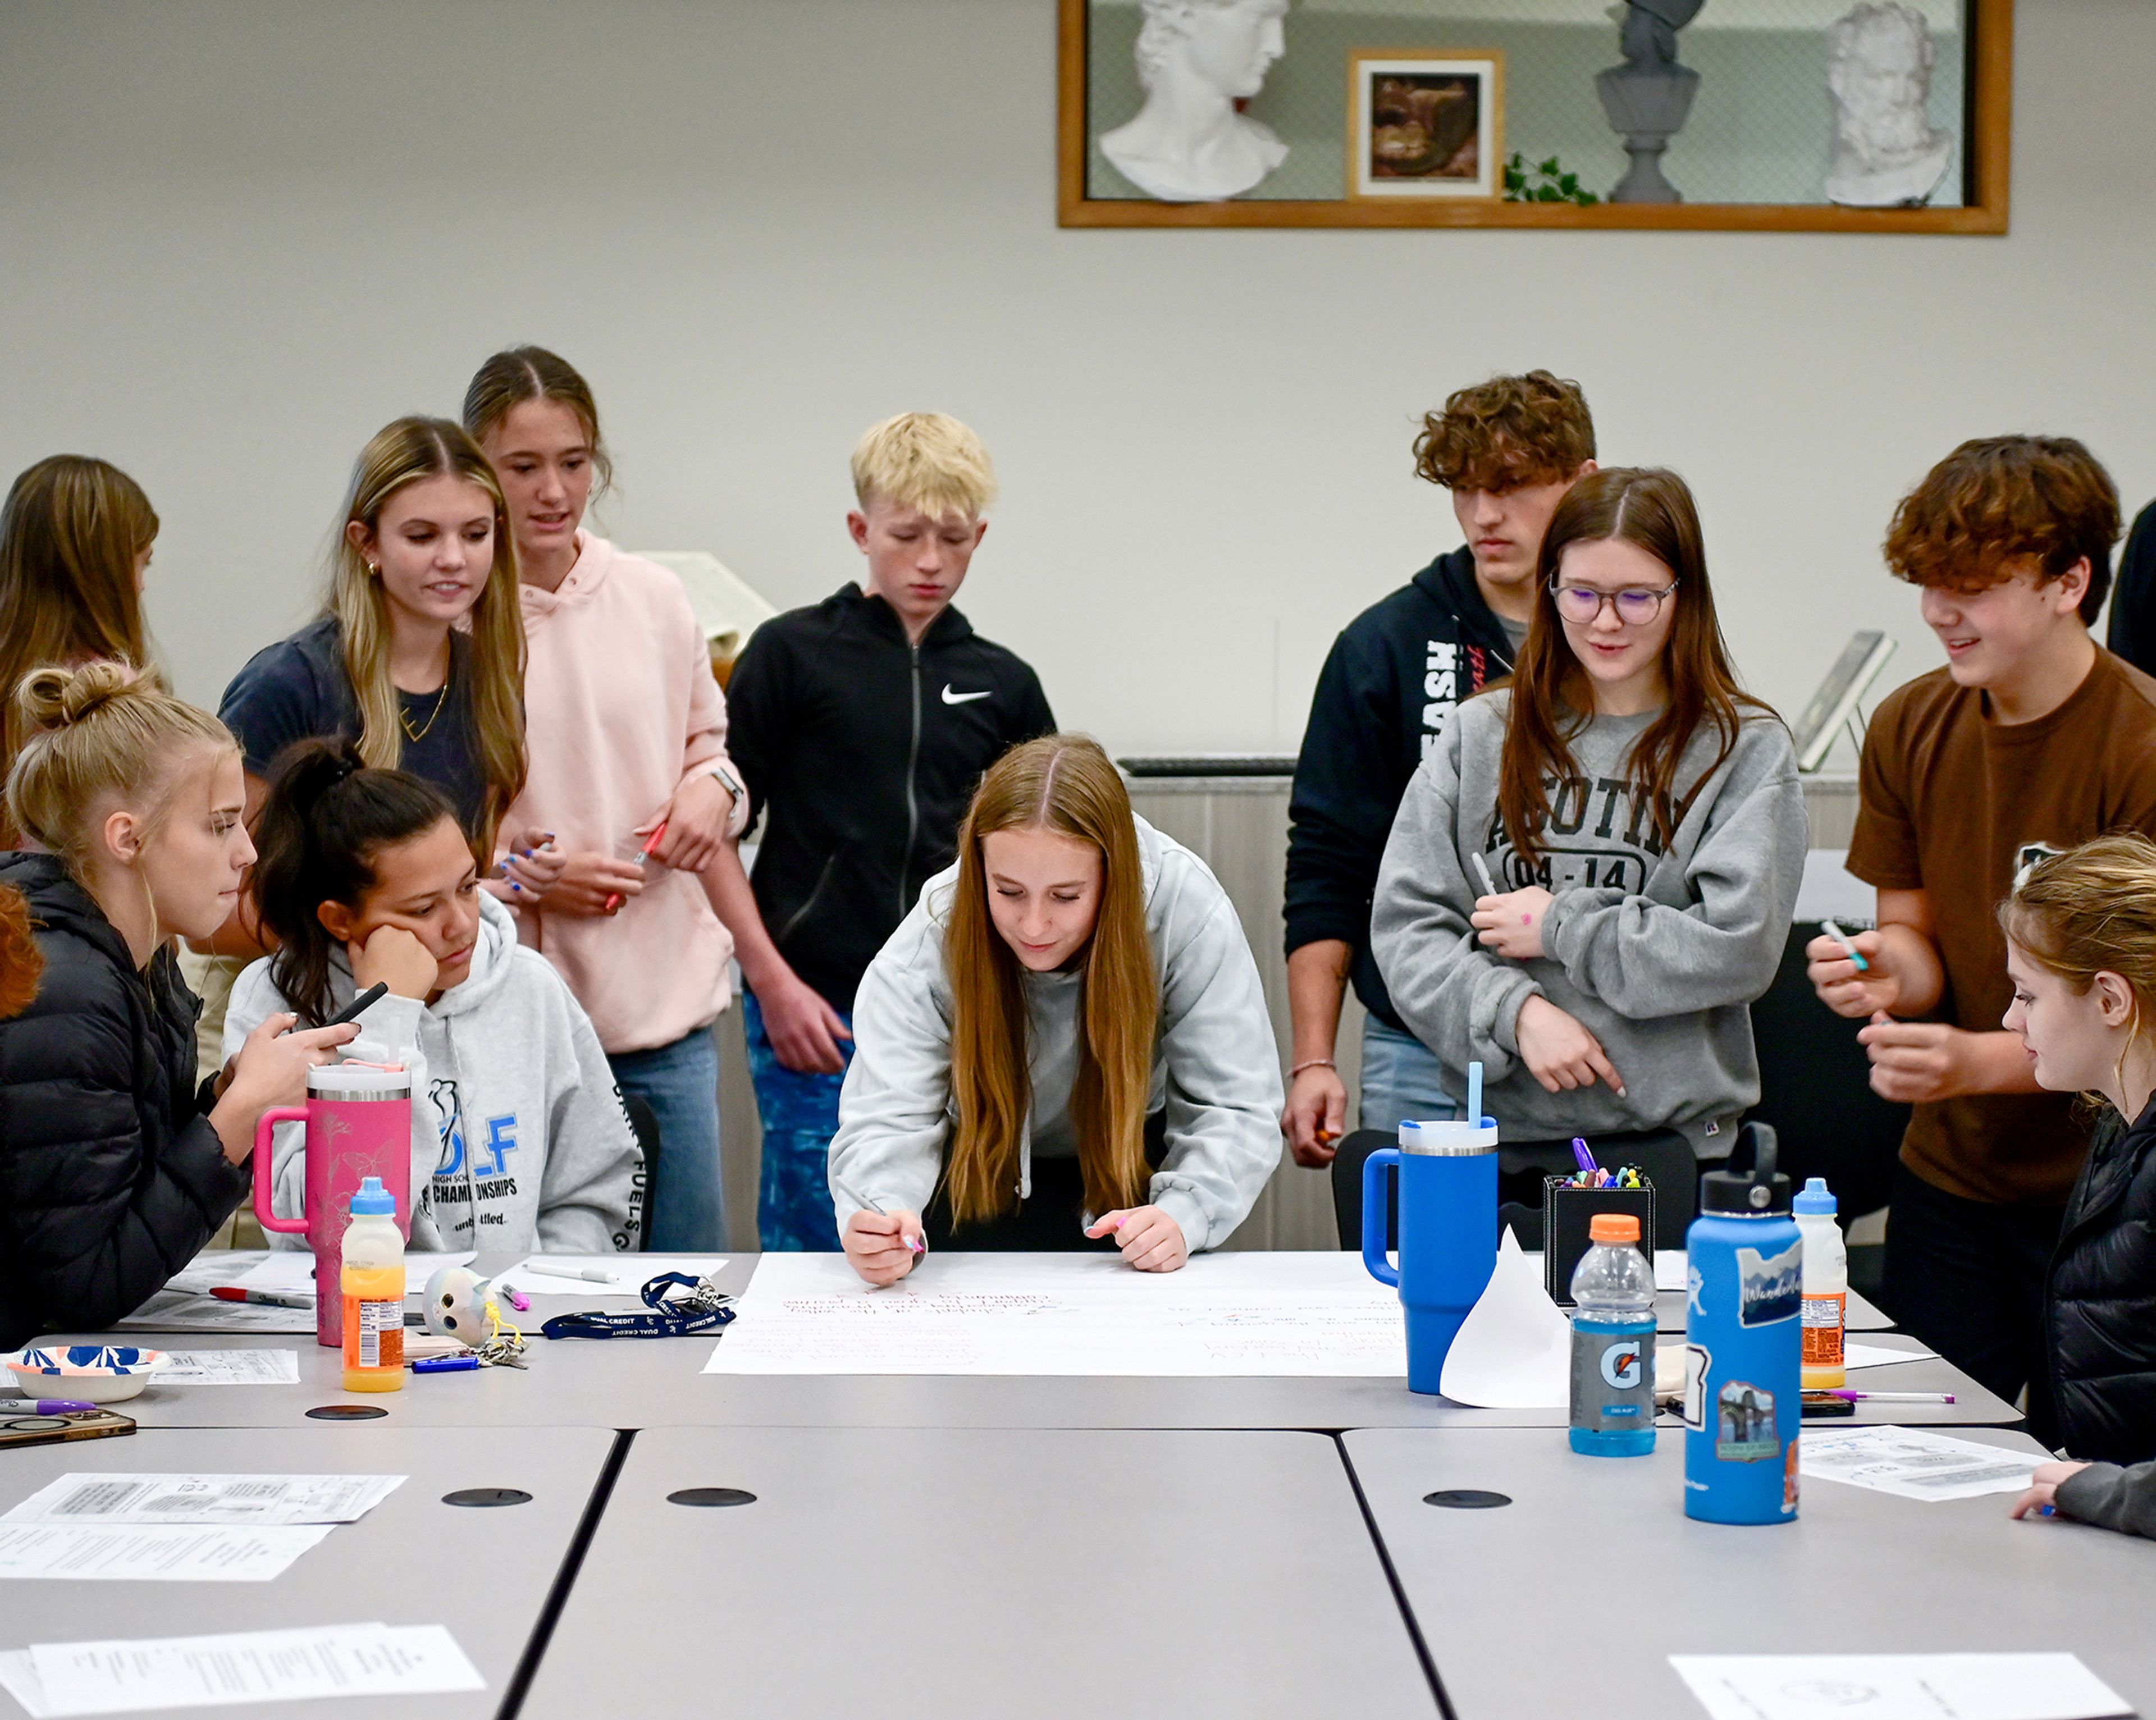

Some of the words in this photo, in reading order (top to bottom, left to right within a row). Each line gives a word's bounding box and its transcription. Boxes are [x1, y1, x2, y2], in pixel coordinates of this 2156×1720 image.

[624, 1160, 646, 1232] FUELS
[685, 1320, 706, 1329] CREDIT
[1600, 1340, 1642, 1389] G
